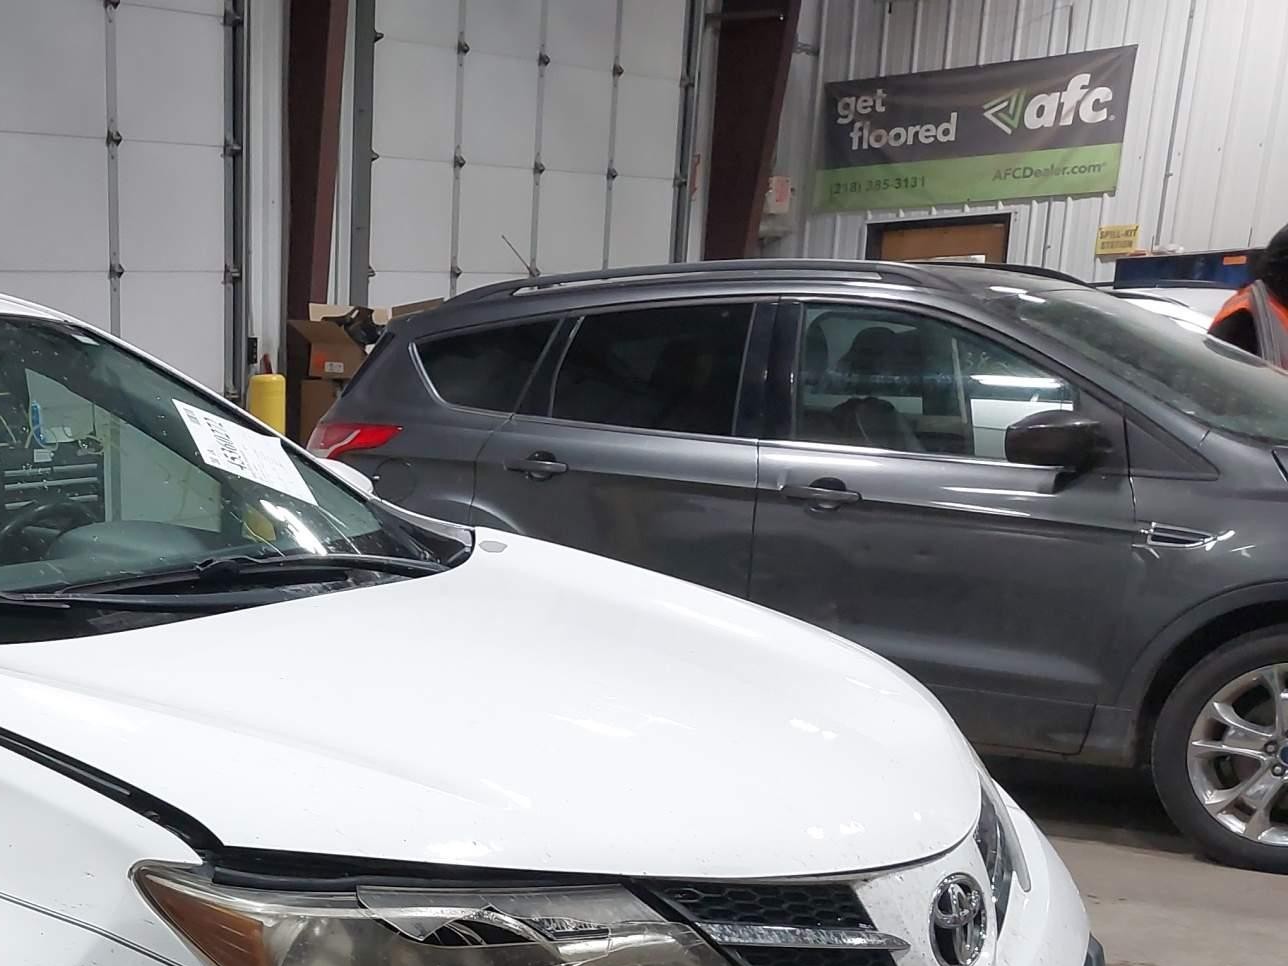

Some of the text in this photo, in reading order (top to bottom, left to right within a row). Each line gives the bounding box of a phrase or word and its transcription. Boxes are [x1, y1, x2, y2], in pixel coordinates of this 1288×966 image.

[836, 88, 887, 125] get
[1023, 73, 1113, 130] afc
[849, 112, 958, 150] floored
